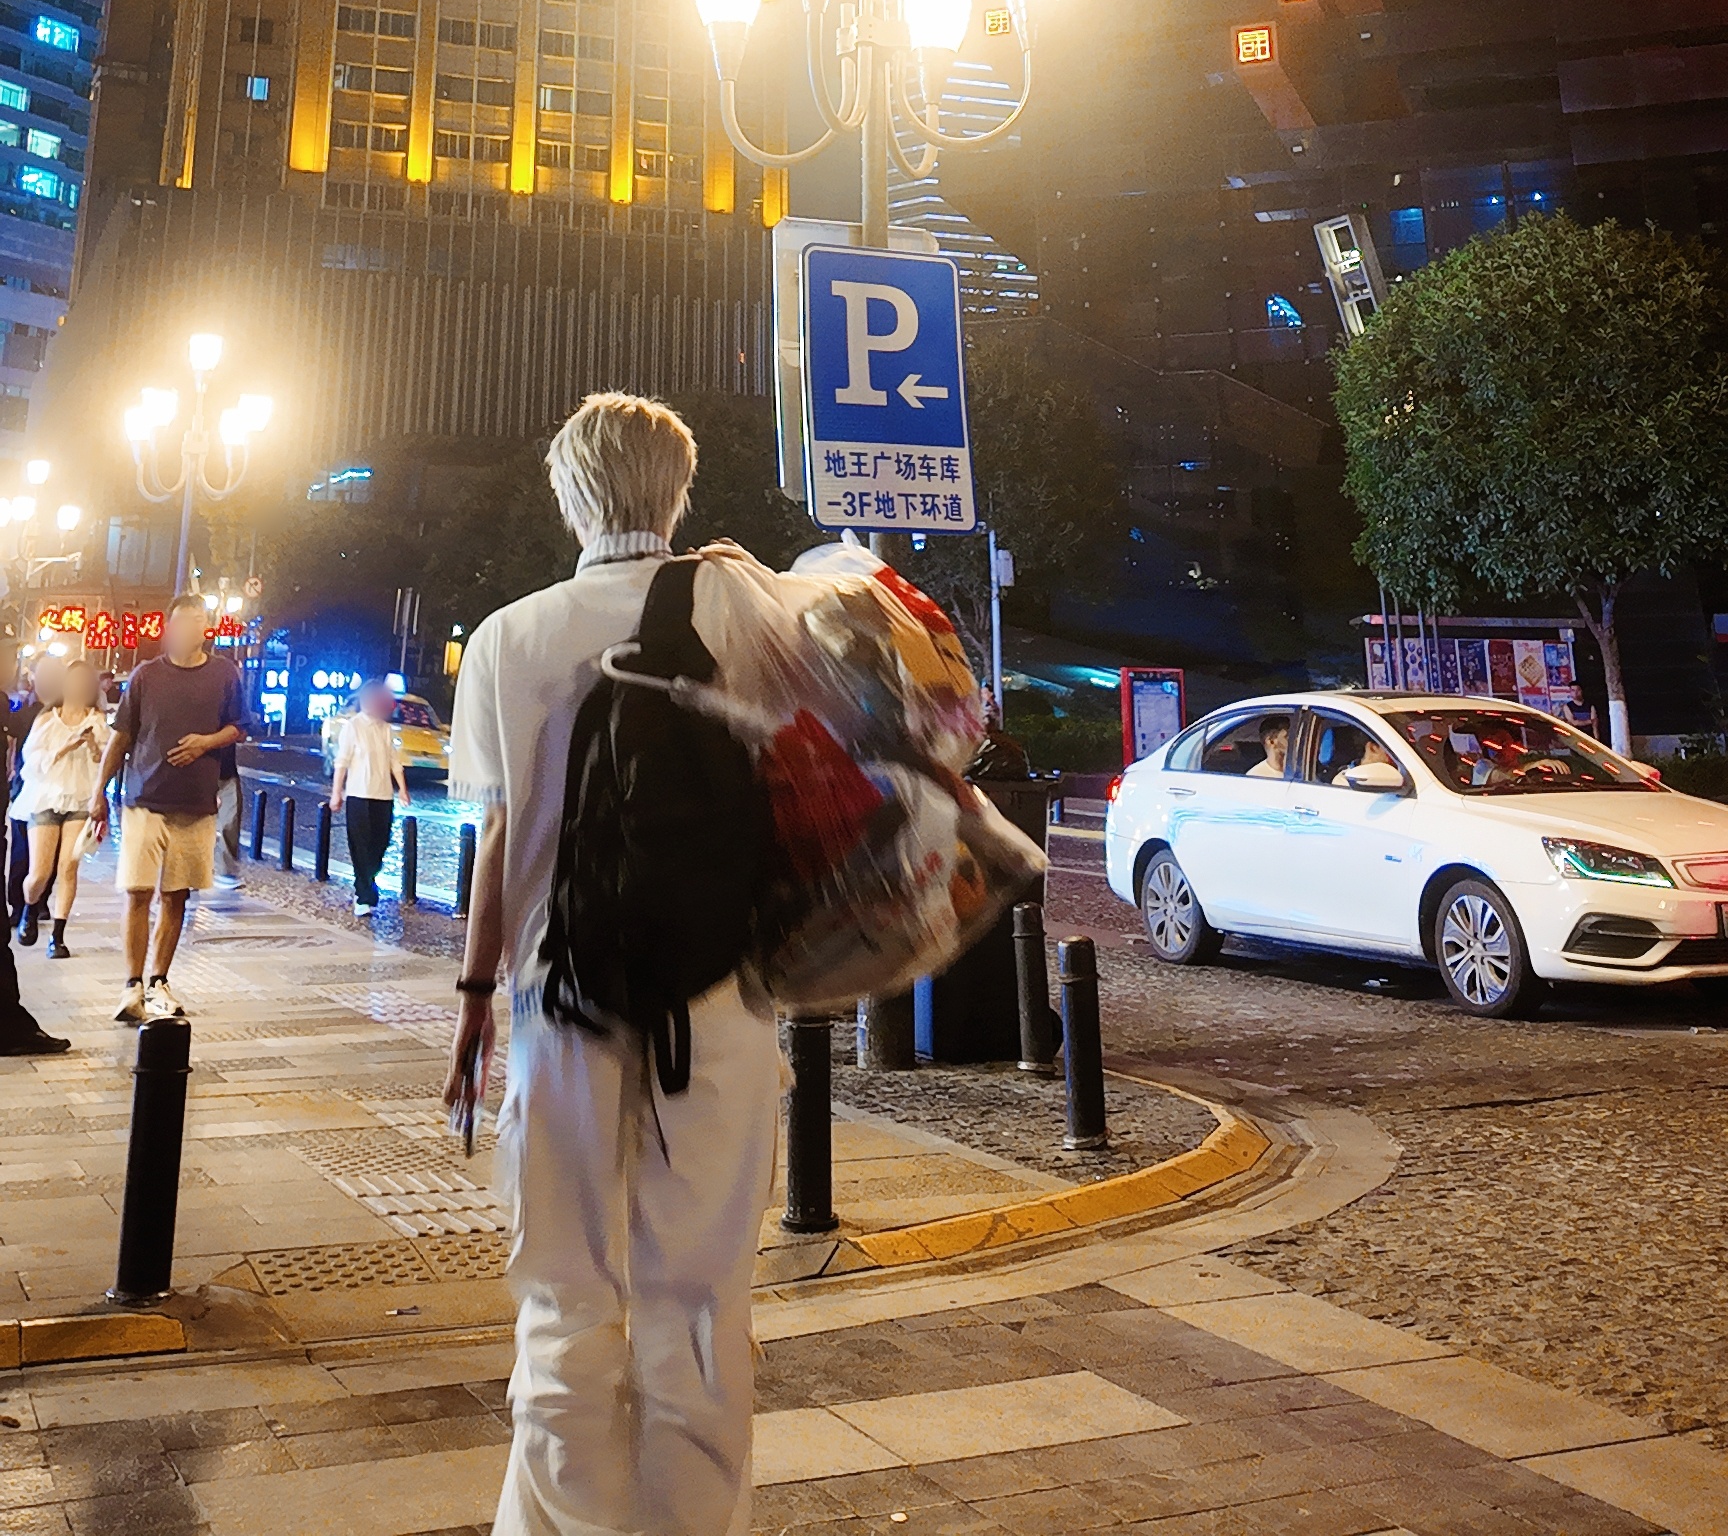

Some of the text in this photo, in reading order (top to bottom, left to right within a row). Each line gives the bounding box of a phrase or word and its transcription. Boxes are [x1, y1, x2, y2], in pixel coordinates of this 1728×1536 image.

[832, 281, 918, 406] P
[824, 449, 961, 484] 地王广场车库
[827, 490, 964, 523] -3F地下环道
